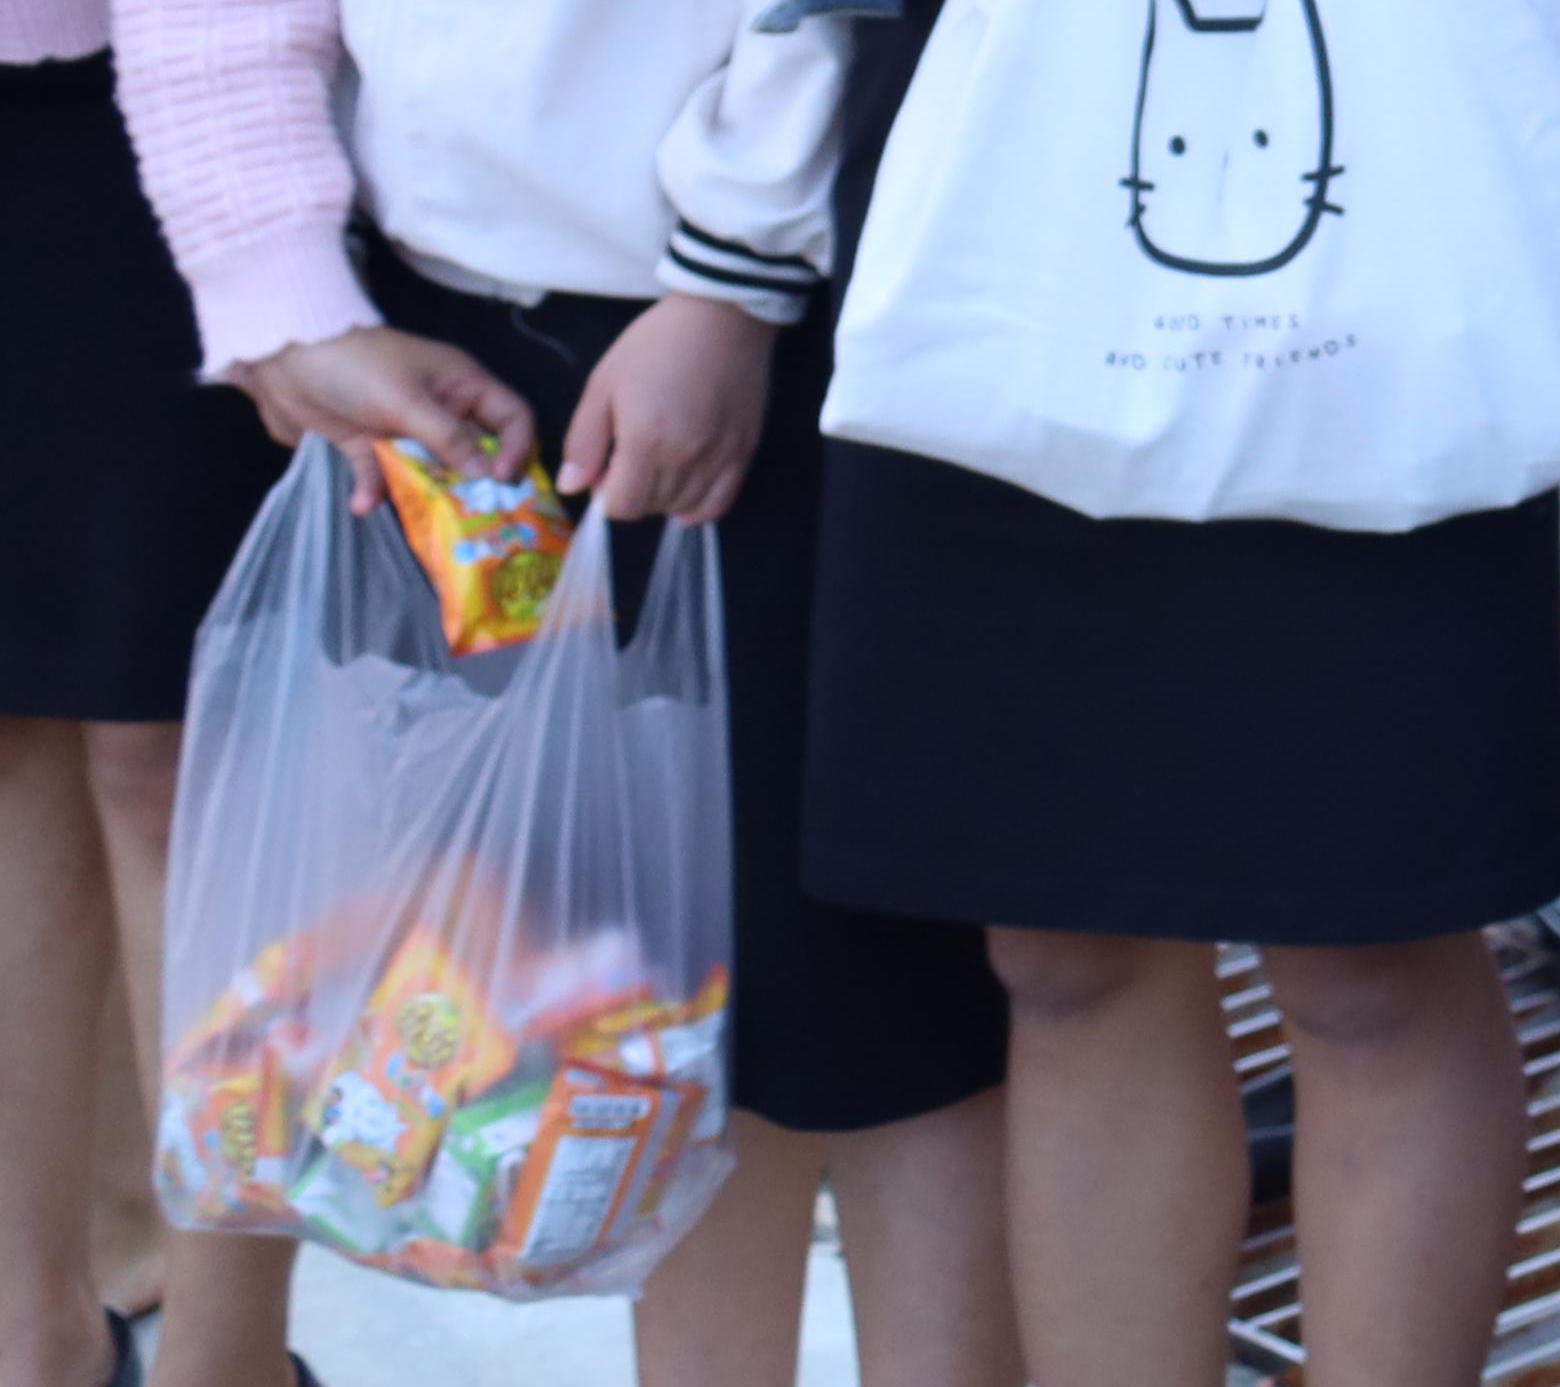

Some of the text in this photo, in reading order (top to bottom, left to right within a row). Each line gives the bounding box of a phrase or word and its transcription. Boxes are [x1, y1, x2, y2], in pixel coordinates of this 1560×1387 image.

[1222, 314, 1300, 331] TIMES
[1163, 351, 1222, 372] CUTE
[1242, 332, 1357, 369] FRIENDS
